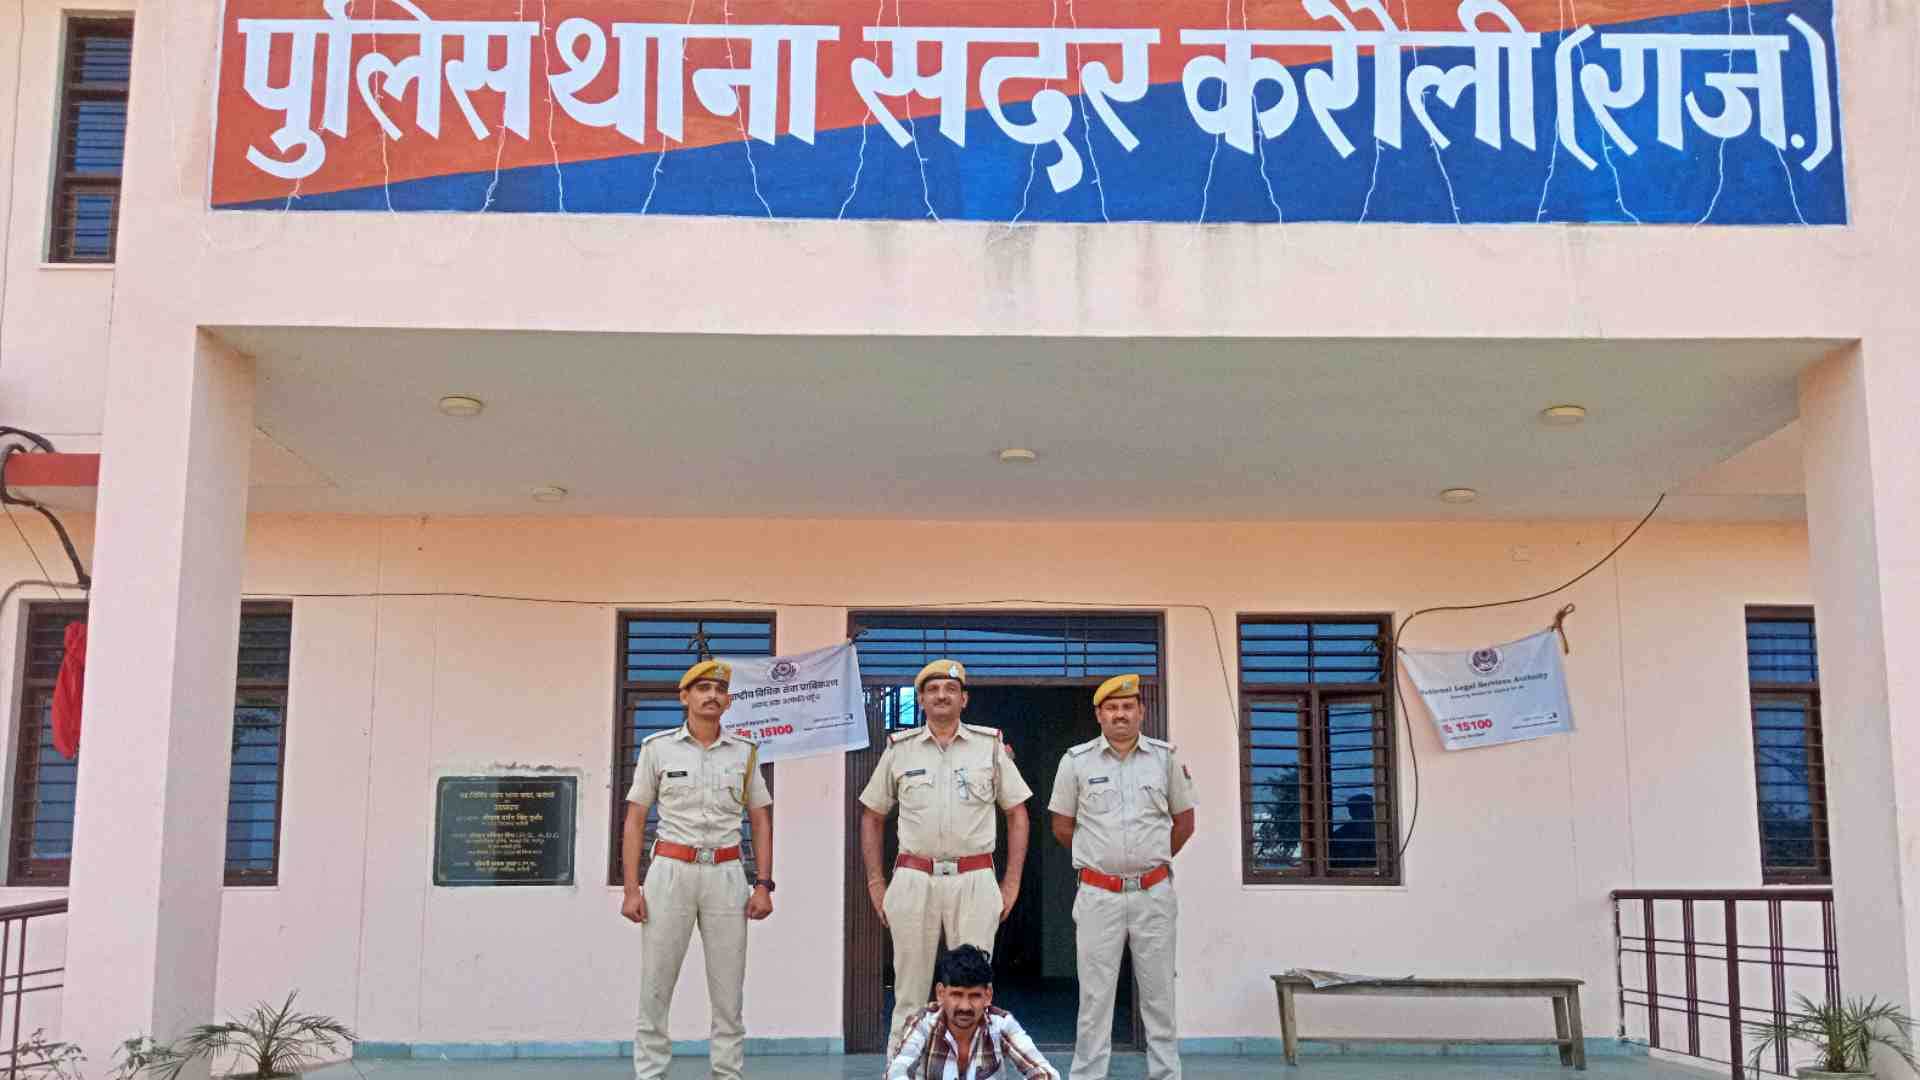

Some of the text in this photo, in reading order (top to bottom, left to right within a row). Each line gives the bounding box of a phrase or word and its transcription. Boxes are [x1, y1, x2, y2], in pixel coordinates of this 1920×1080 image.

[238, 0, 1833, 193] पुलिस थाना सदर करौली (राज.)
[1454, 683, 1477, 693] Legal
[1477, 678, 1512, 688] Services
[1513, 671, 1549, 683] Authority
[759, 724, 794, 738] 15100
[1455, 718, 1493, 732] 15100
